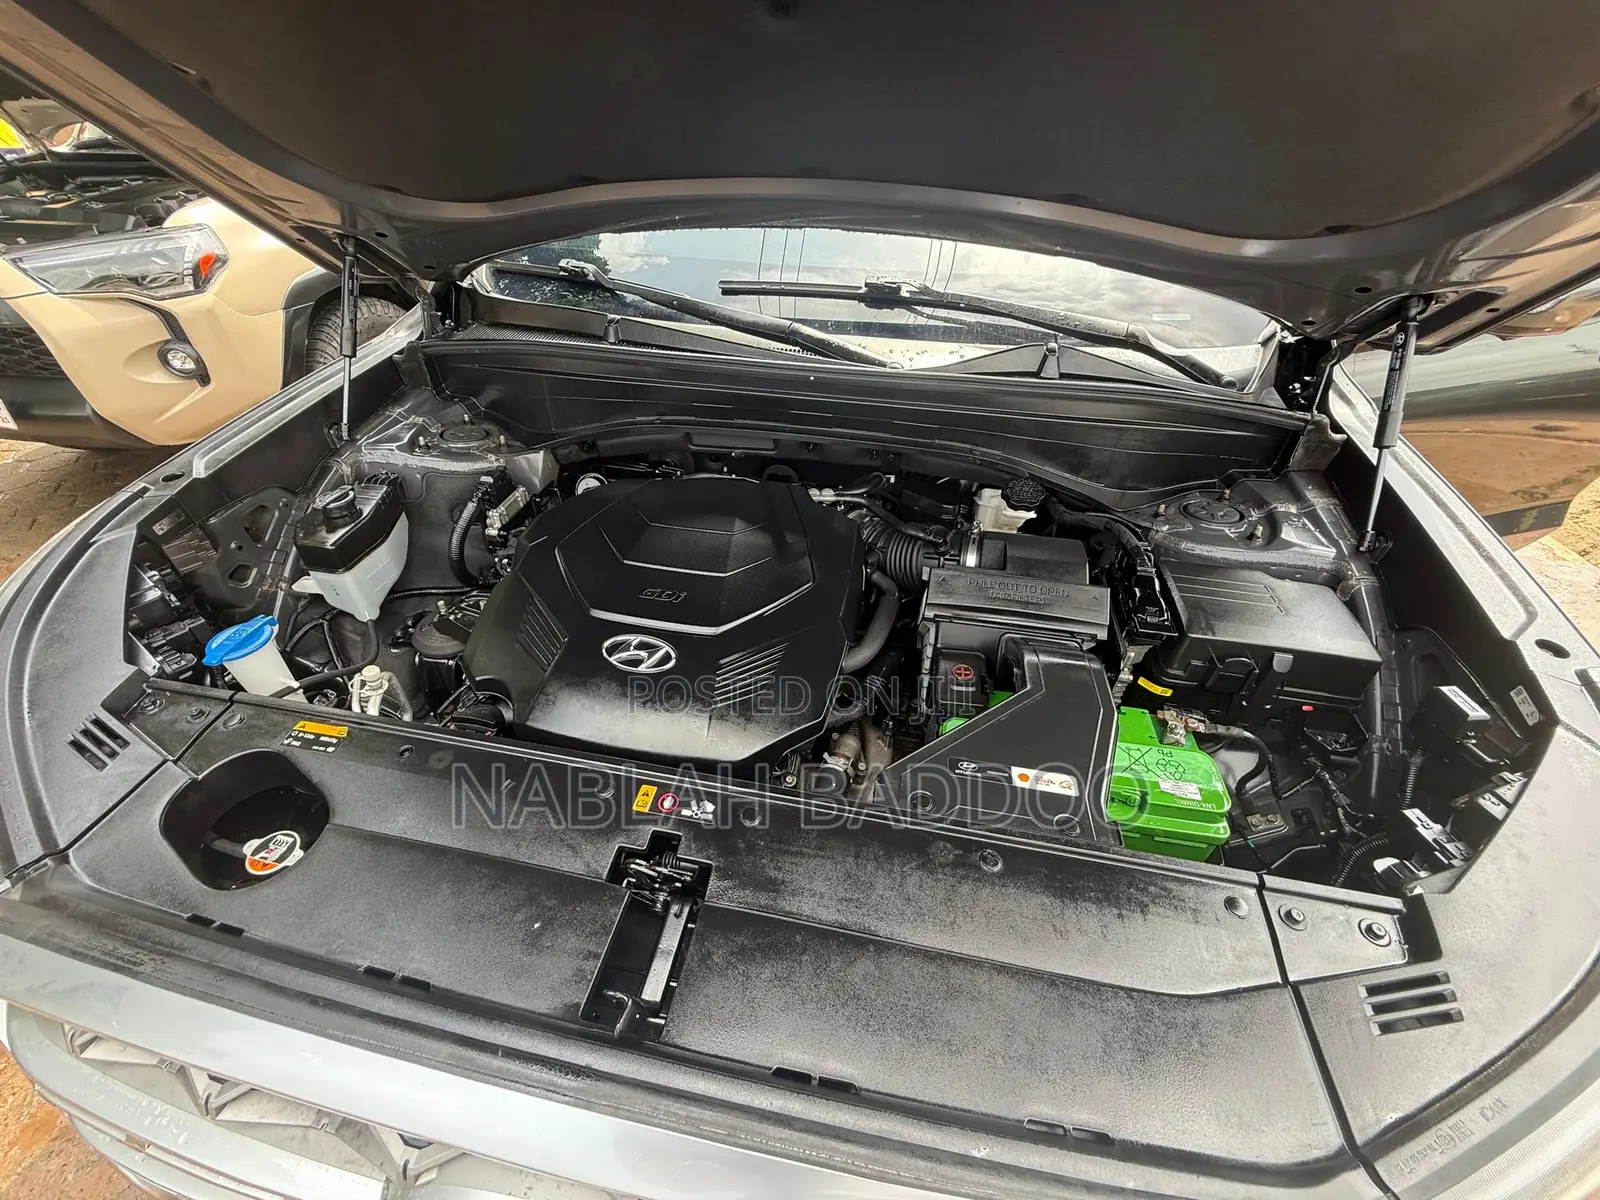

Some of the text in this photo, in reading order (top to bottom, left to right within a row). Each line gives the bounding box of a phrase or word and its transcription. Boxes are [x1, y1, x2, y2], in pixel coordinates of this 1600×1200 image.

[968, 577, 1070, 598] PULL OUT TO OPEN
[1157, 748, 1174, 758] Pb
